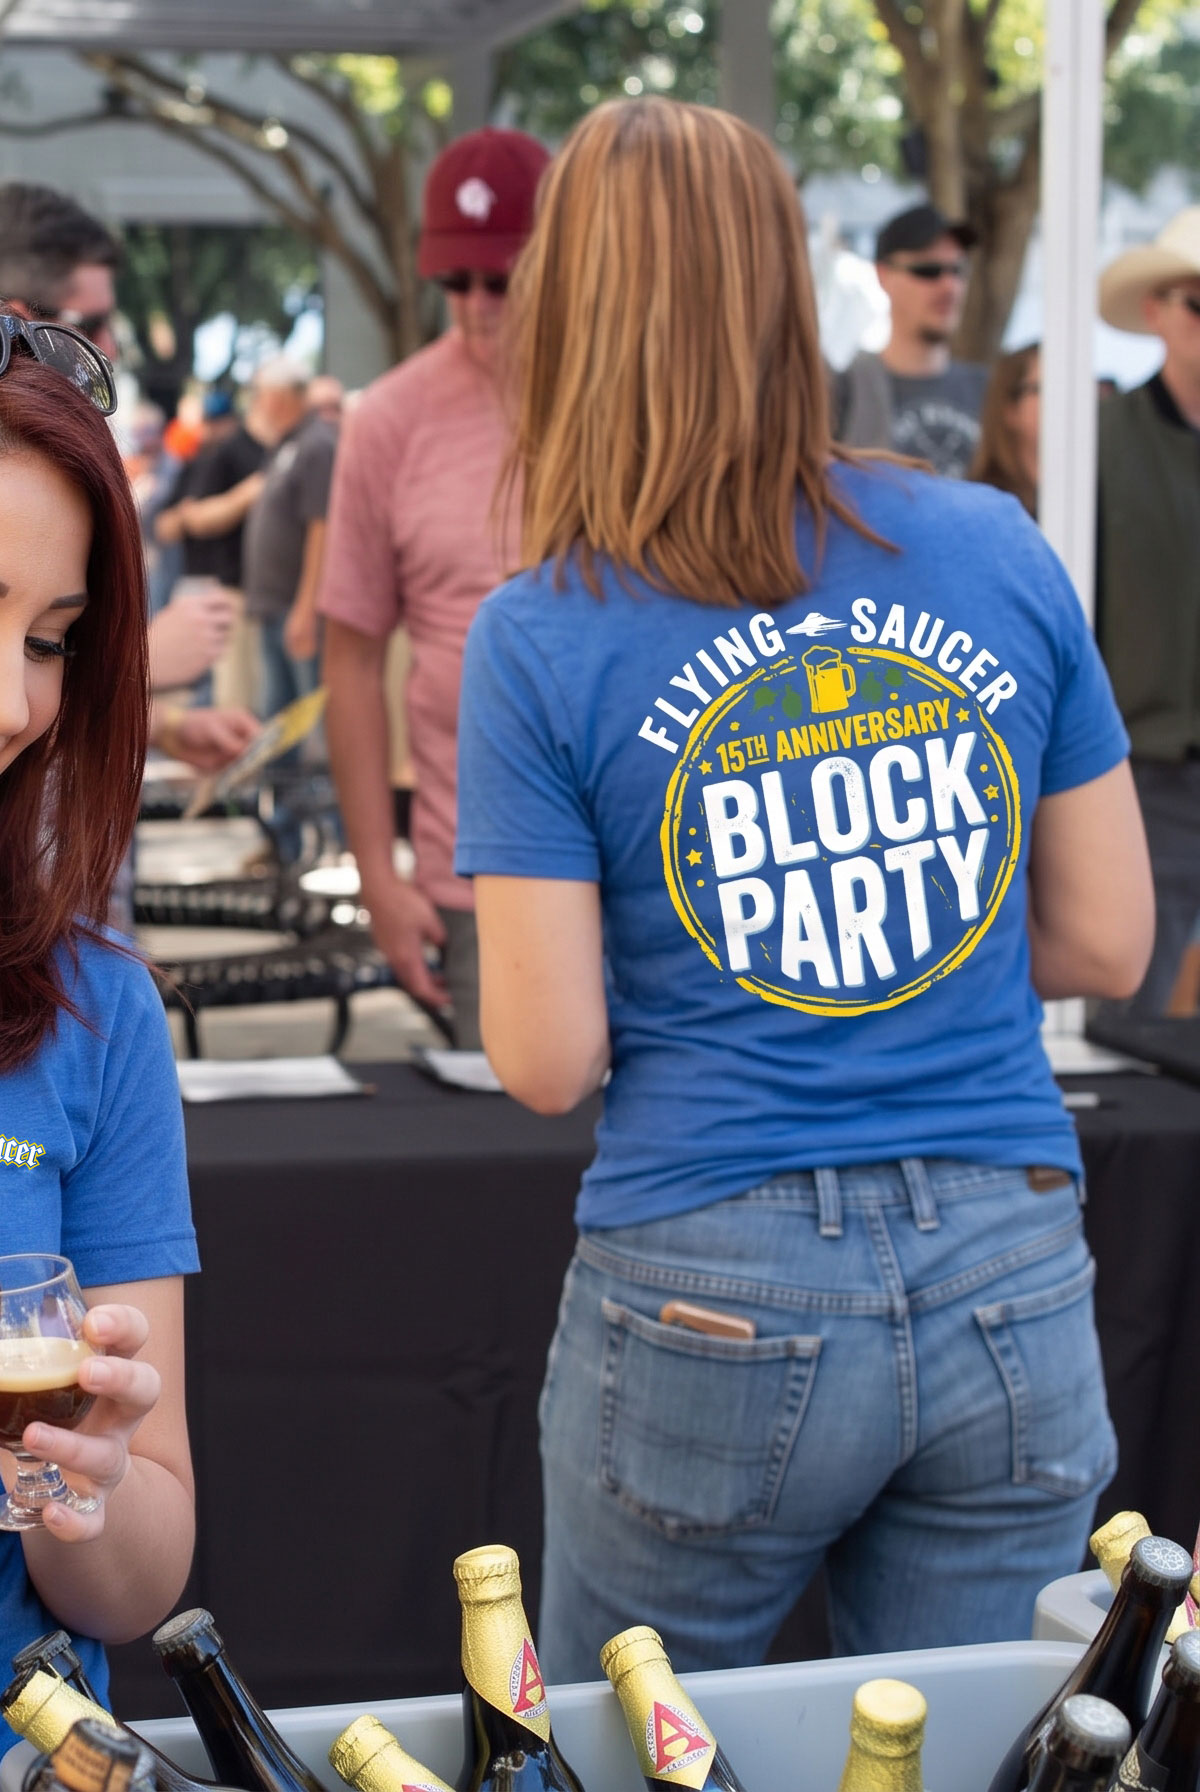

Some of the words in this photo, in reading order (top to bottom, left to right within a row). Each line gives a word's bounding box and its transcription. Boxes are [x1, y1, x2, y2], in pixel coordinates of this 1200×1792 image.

[638, 612, 786, 754] FLYING
[850, 597, 1019, 715] SAUCER
[716, 734, 770, 774] 15TH
[776, 698, 951, 762] ANNIVERSARY
[702, 731, 988, 878] BLOCK
[718, 828, 990, 988] PARTY
